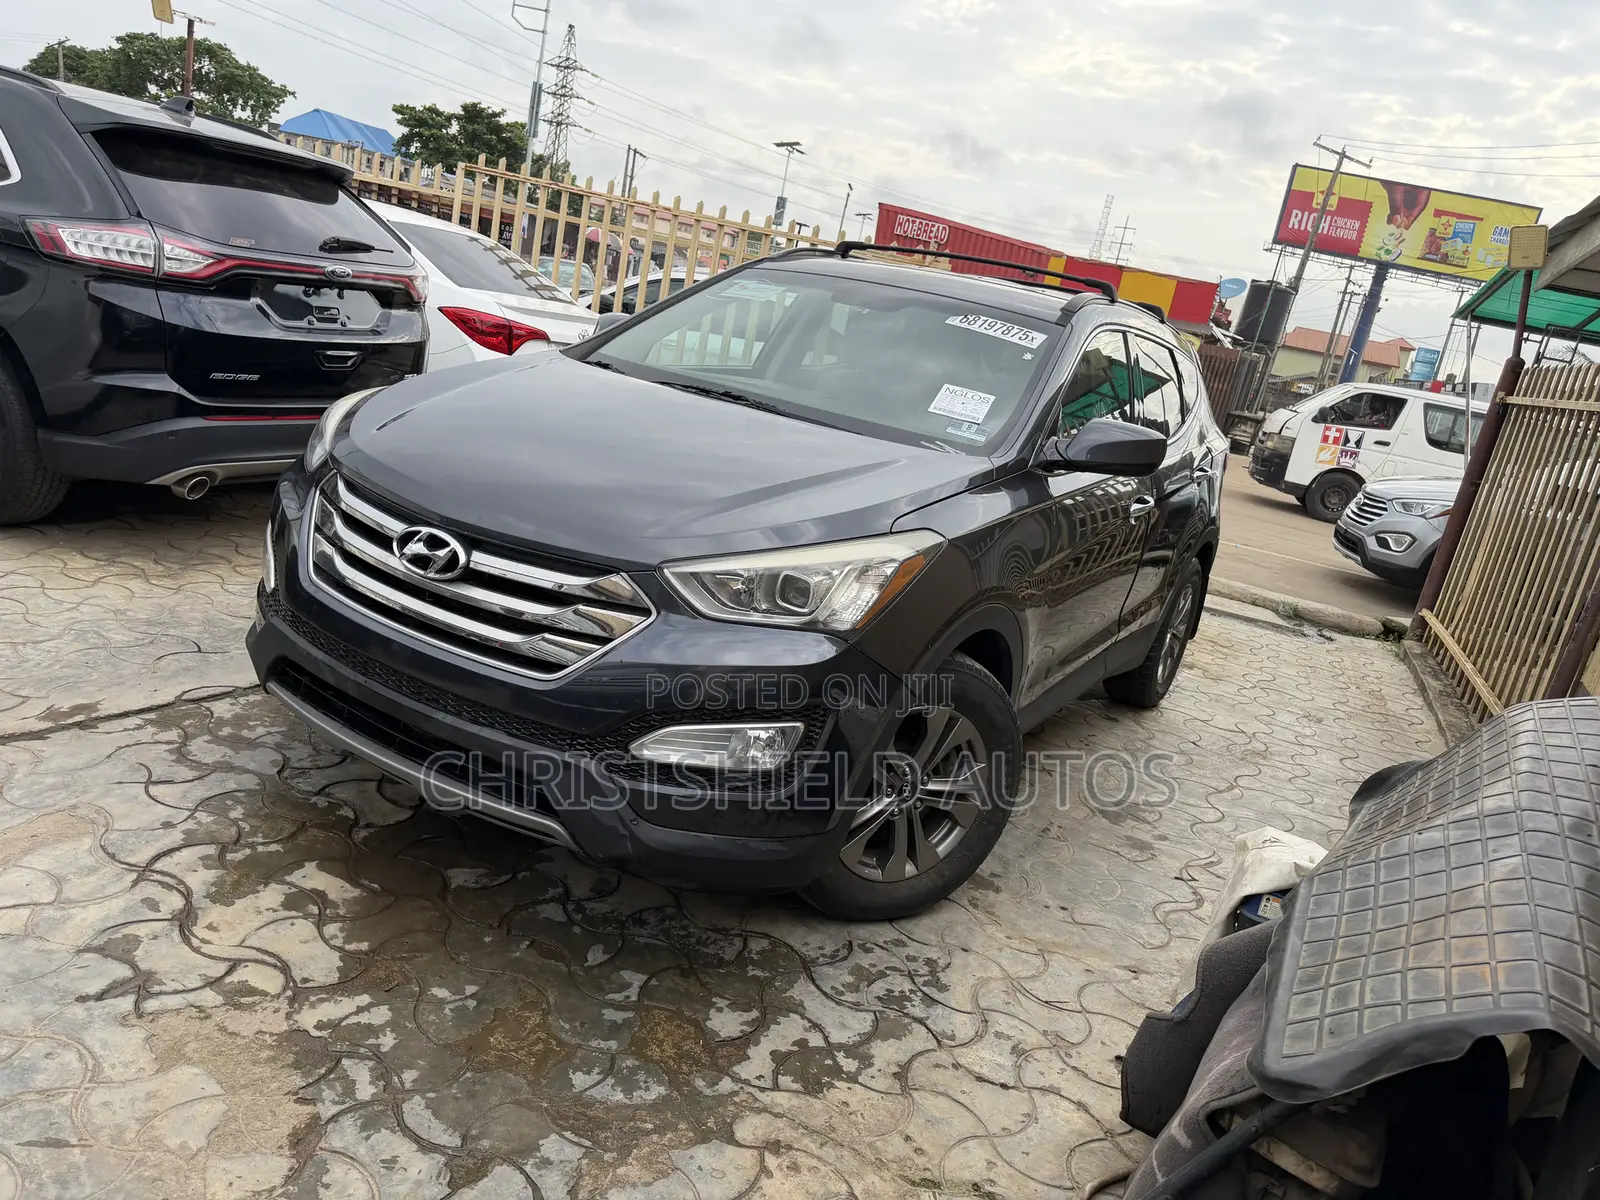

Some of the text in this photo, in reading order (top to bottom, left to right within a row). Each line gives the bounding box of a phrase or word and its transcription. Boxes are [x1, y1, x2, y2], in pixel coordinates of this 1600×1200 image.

[1331, 216, 1360, 230] CHICKEN
[1329, 226, 1357, 240] FLAVOUR
[1492, 226, 1509, 238] GAM
[209, 372, 261, 381] EDGE
[944, 387, 991, 404] NGLOS
